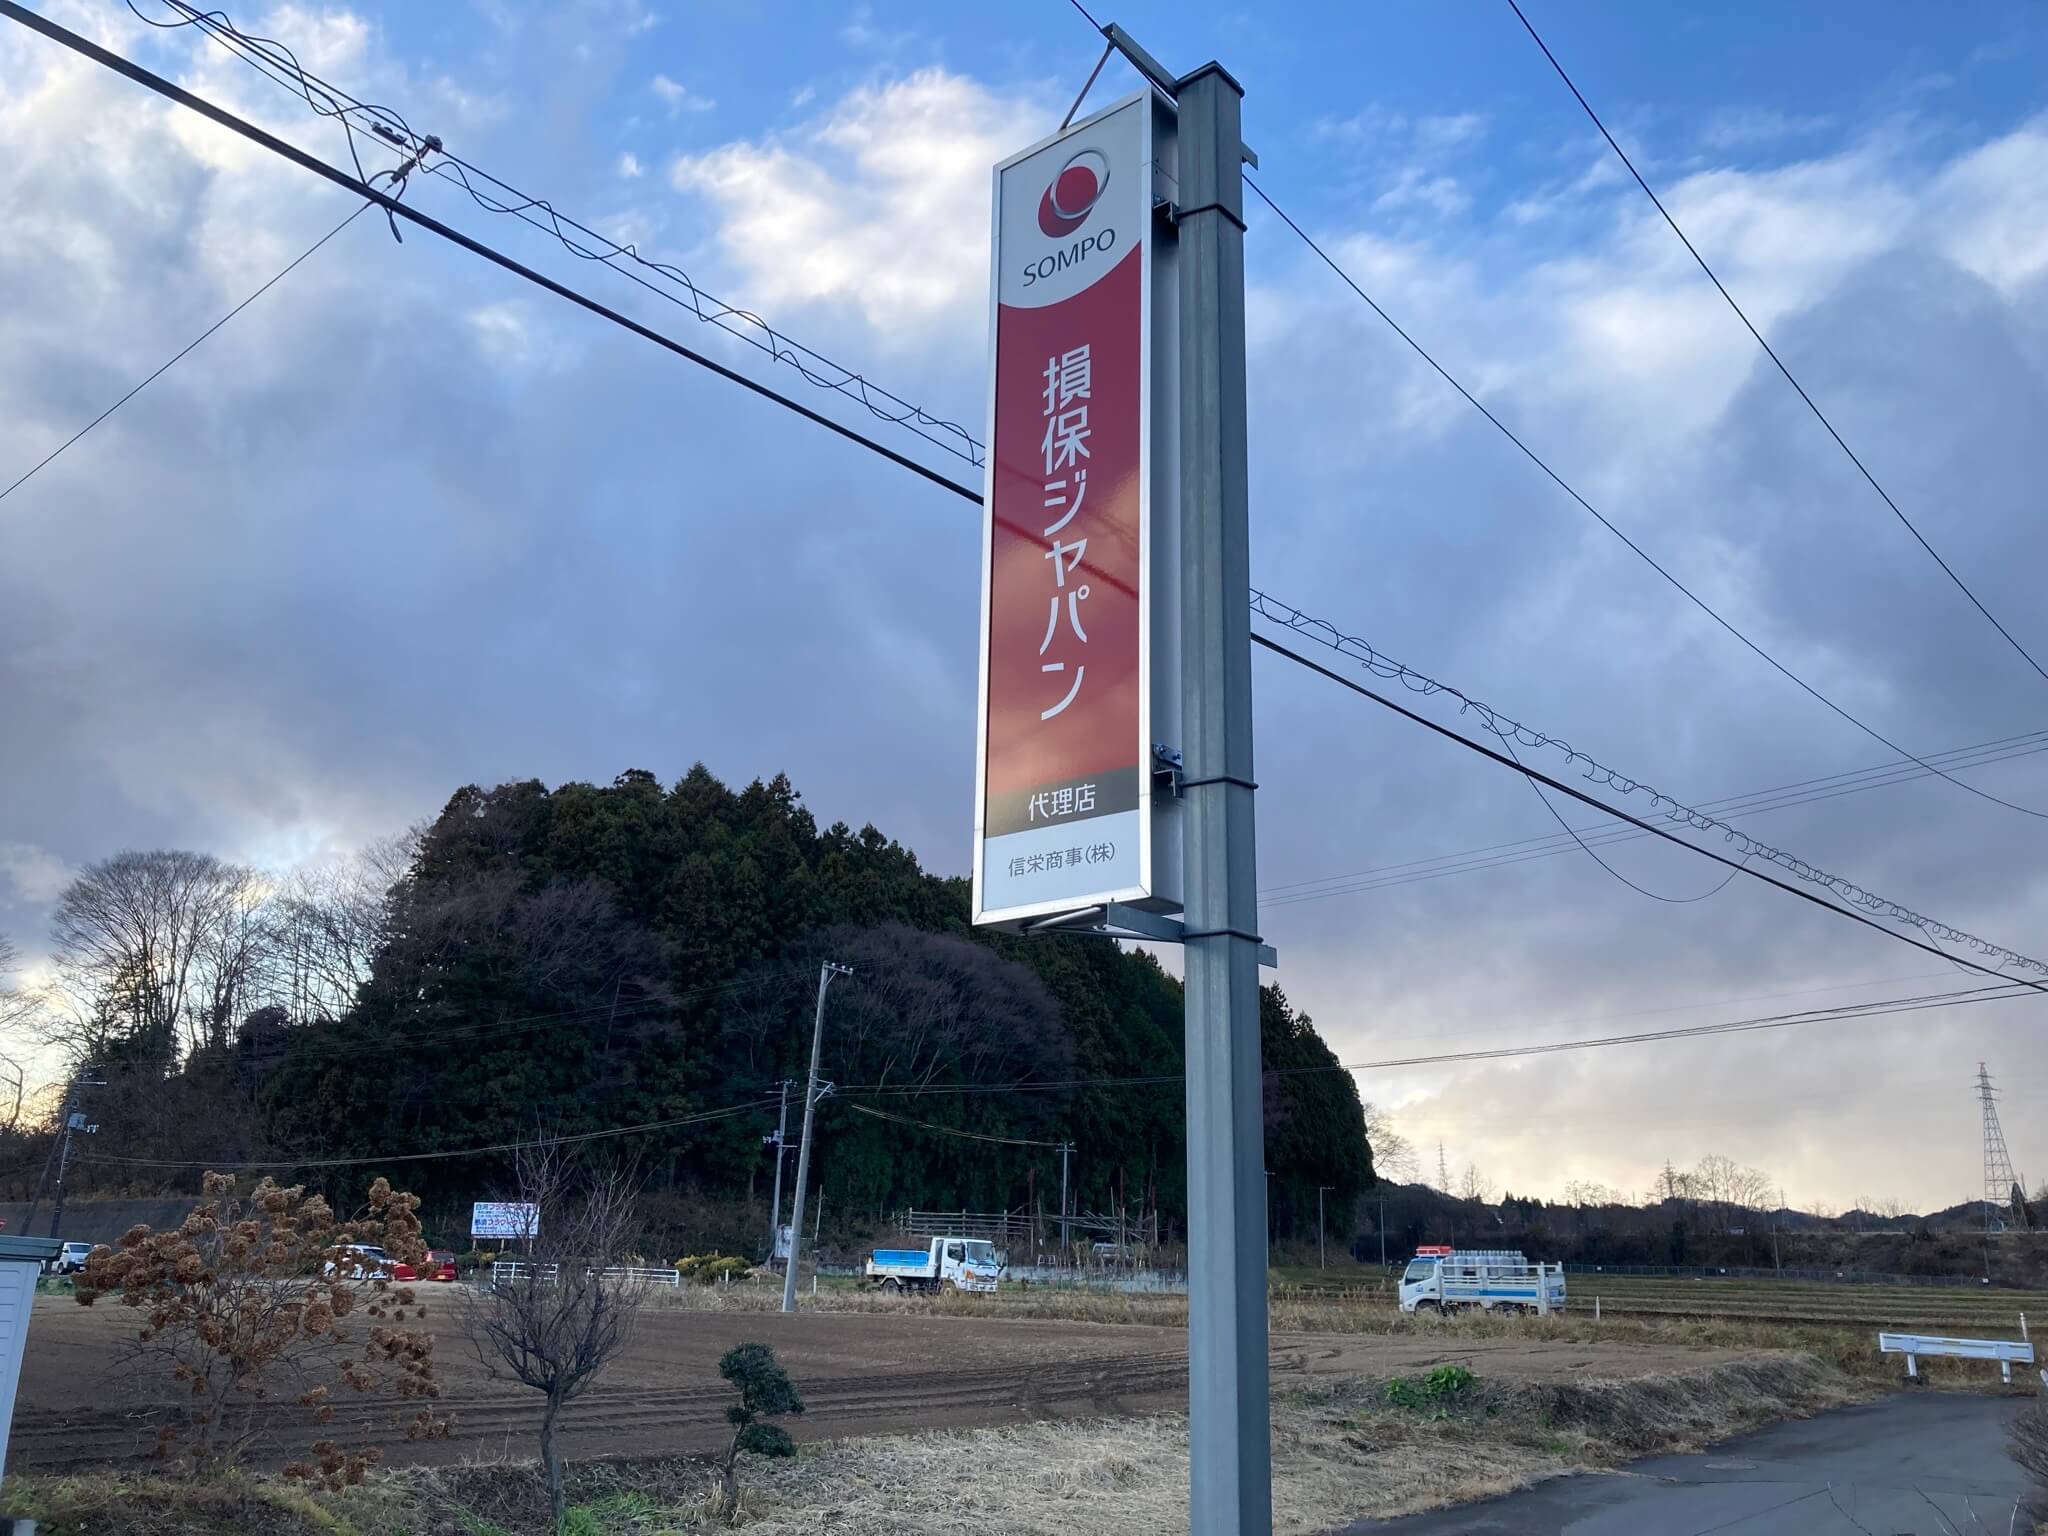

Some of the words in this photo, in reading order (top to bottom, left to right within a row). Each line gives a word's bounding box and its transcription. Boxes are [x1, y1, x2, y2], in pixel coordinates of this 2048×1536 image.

[1022, 228, 1116, 287] SOMPO
[1039, 343, 1092, 721] 損保ジャパン
[1028, 783, 1097, 822] 代理店
[1008, 841, 1115, 878] 信栄商事(株)
